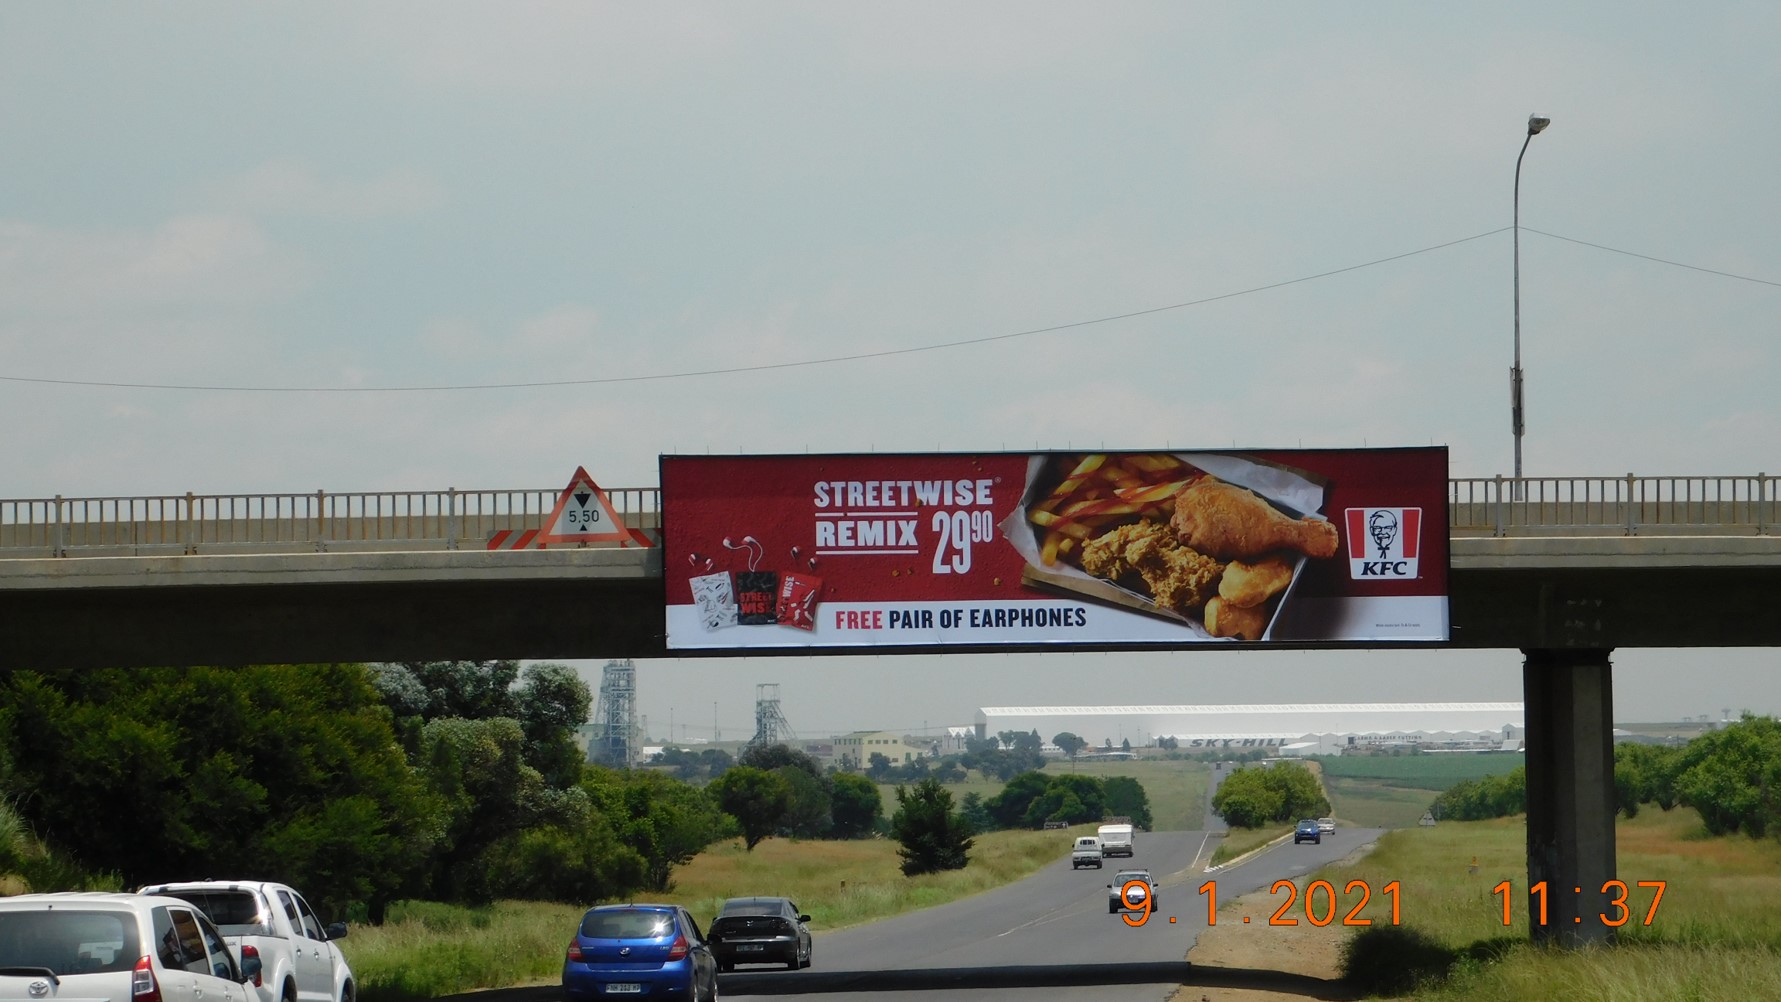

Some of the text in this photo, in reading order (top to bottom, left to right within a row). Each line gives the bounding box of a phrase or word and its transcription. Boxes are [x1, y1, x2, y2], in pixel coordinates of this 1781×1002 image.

[815, 520, 918, 547] REMIX
[1361, 561, 1407, 575] KFC
[836, 607, 1087, 630] FREE PAIR OF EARPHONES
[1189, 738, 1289, 748] SKY-HILL
